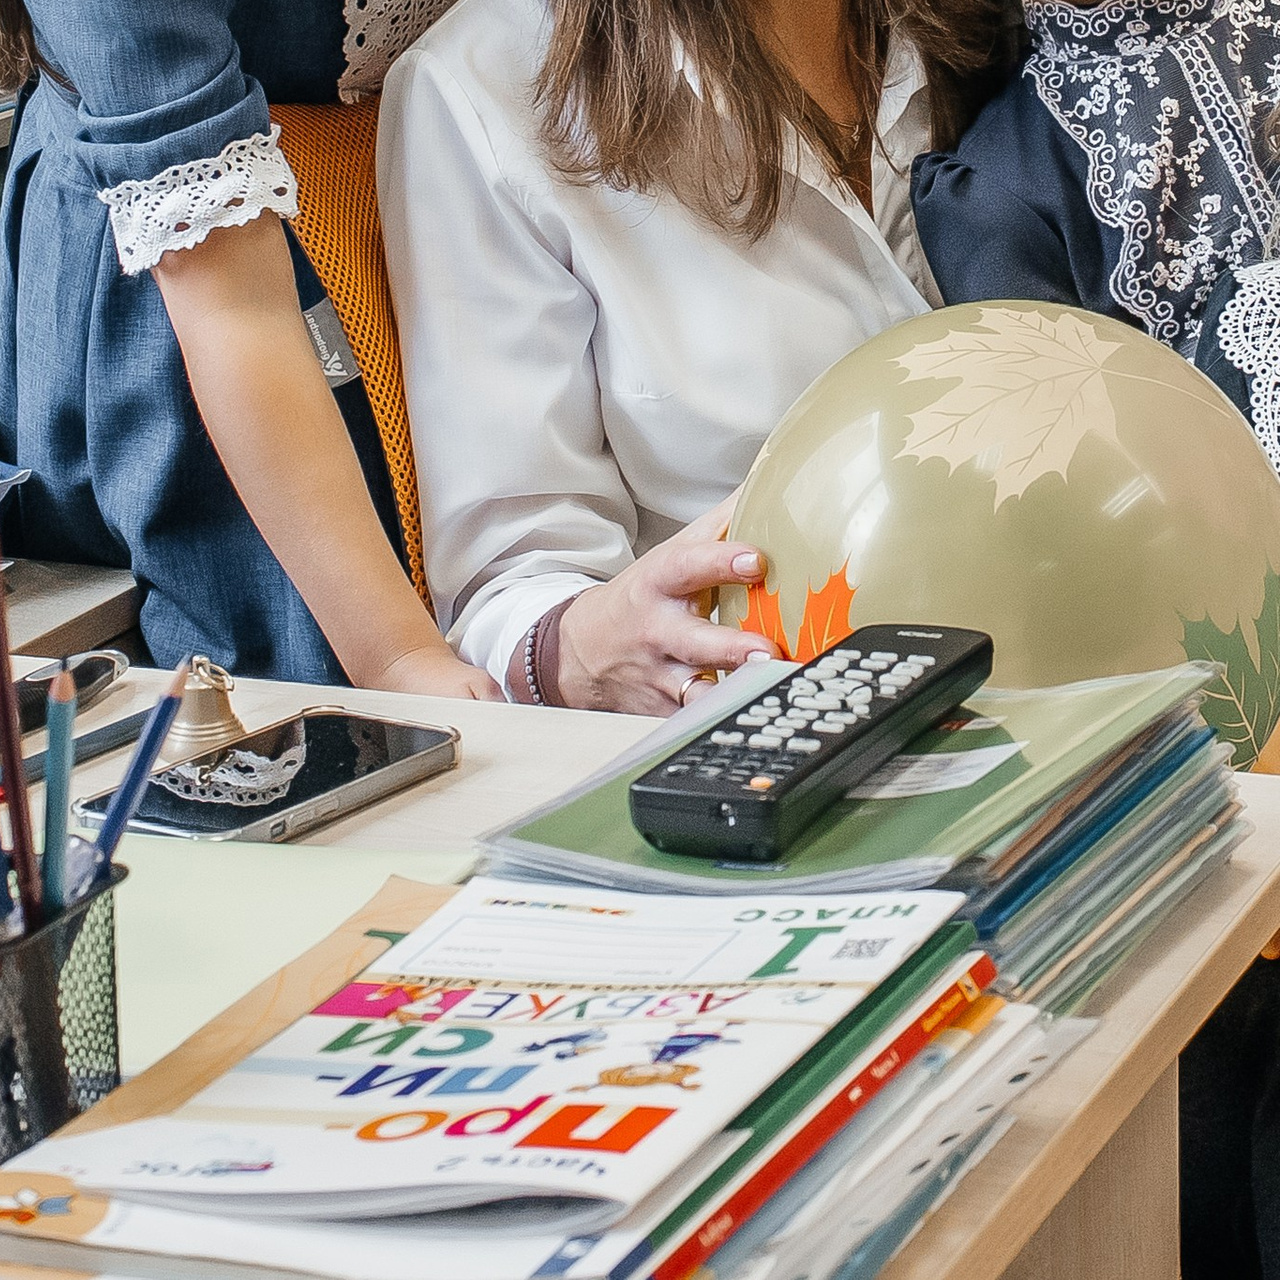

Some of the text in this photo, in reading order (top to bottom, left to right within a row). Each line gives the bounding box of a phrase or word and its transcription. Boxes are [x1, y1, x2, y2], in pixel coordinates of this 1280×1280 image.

[304, 313, 331, 361] бюрократ
[732, 903, 919, 923] КЛАСС
[750, 925, 846, 978] 1
[469, 991, 749, 1021] АЗБУКЕ
